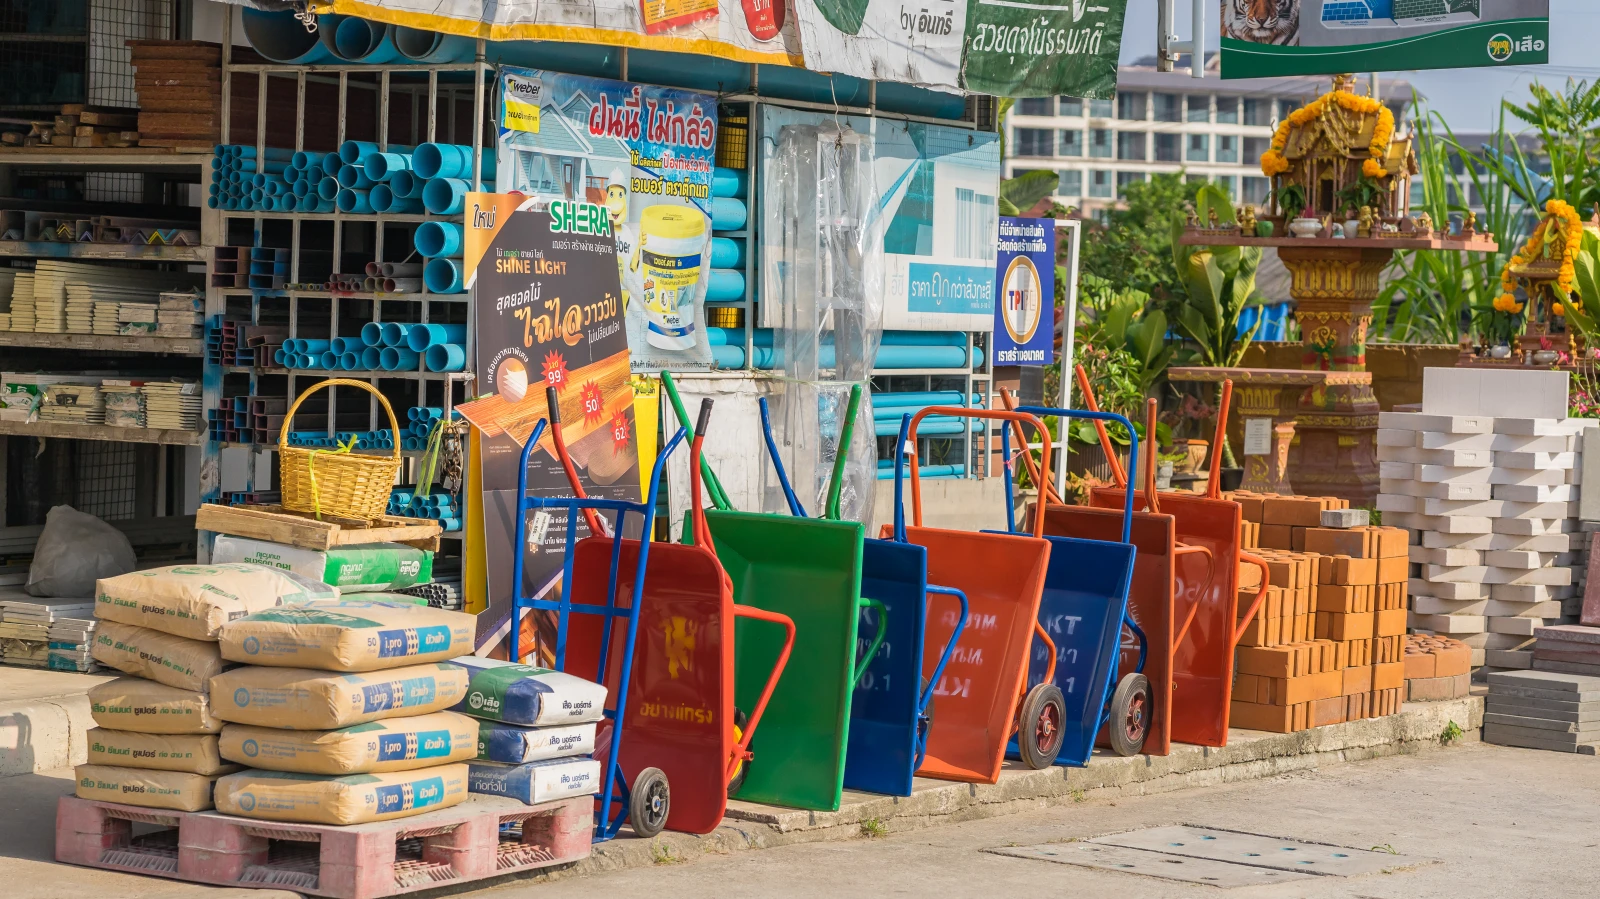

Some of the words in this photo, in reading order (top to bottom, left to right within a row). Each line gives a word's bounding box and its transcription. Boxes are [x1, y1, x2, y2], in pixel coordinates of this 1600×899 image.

[900, 5, 916, 39] by
[918, 8, 953, 36] อินทรี
[1515, 34, 1545, 52] เสือ
[513, 81, 541, 95] weber
[589, 87, 642, 141] ฝนนี้
[647, 101, 716, 149] ไม่กลัว
[630, 149, 640, 166] ใช้
[663, 151, 711, 172] ป้องกันรั่วซึม
[631, 175, 664, 195] เวเบอร์
[666, 177, 709, 203] ตราตุ๊กแก
[473, 203, 497, 230] ใหม่
[550, 200, 612, 237] SHERA
[1000, 220, 1045, 237] ที่นี่จำหน่ายสินค้า
[496, 258, 531, 274] SHINE
[534, 260, 567, 275] LIGHT
[496, 282, 542, 315] สุดยอดไม้
[998, 346, 1045, 362] เราสร้างอนาคต
[548, 370, 561, 384] 99
[586, 399, 598, 413] 50
[615, 427, 626, 440] 62
[98, 593, 112, 605] เสือ
[141, 604, 165, 615] ซูเปอร์
[1046, 614, 1082, 635] KT
[367, 637, 377, 646] 50
[384, 637, 402, 649] i.pro
[97, 634, 113, 647] เสือ
[139, 651, 162, 665] ซูเปอร์
[932, 675, 972, 698] KT
[352, 694, 361, 703] 50
[483, 696, 500, 708] เสือ
[562, 700, 572, 709] เสือ
[573, 700, 592, 709] มอร์ตาร์
[92, 703, 106, 713] เสือ
[134, 706, 157, 716] ซูเปอร์
[367, 742, 376, 751] 50
[549, 736, 560, 745] เสือ
[562, 734, 582, 743] มอร์ตาร์
[92, 742, 105, 753] เสือ
[133, 749, 156, 758] ซูเปอร์
[384, 742, 402, 755] i.pro
[80, 777, 95, 788] เสือ
[122, 784, 145, 793] ซูเปอร์
[475, 779, 507, 792] ก่อทั่วไป
[561, 773, 570, 784] เสือ
[572, 772, 590, 781] มอร์ตาร์
[365, 794, 374, 803] 50
[382, 793, 399, 806] i.pro
